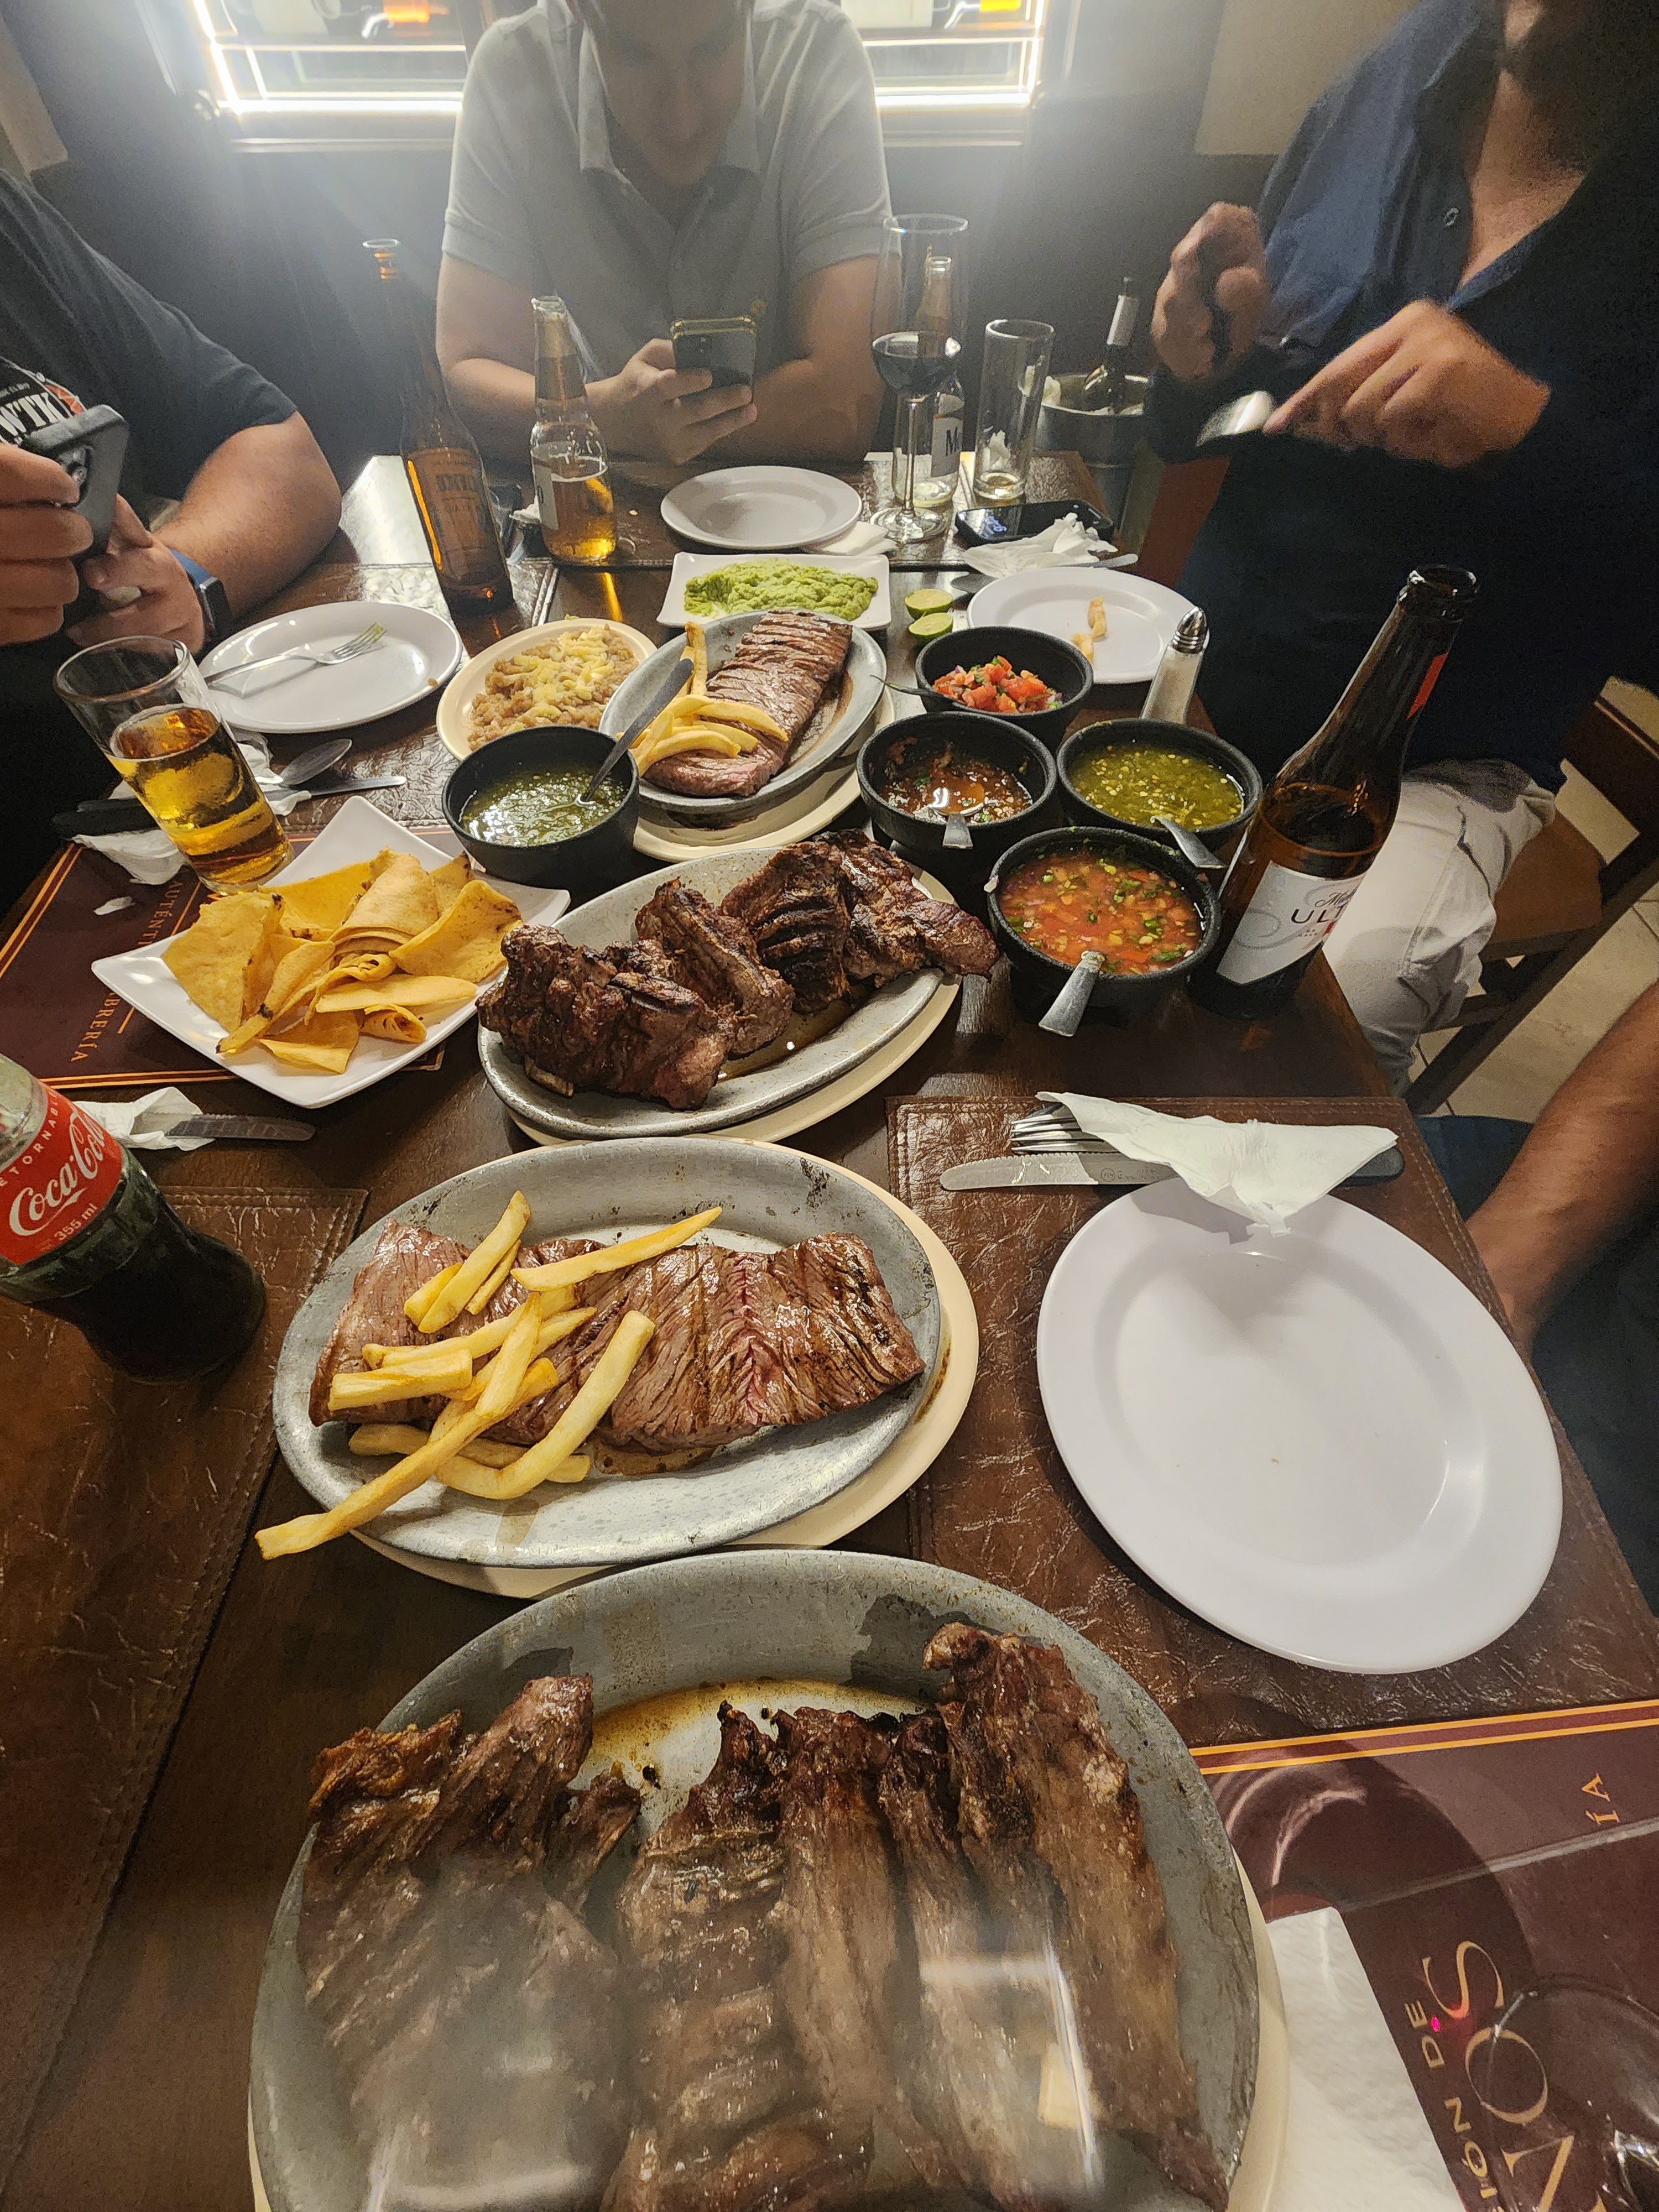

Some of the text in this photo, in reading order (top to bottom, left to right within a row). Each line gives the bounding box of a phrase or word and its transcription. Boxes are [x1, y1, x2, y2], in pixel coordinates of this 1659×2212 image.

[1291, 901, 1350, 924] ULT
[70, 992, 121, 1062] BRERÍA
[54, 1203, 98, 1241] 355 ml
[1405, 2000, 1444, 2069] DE
